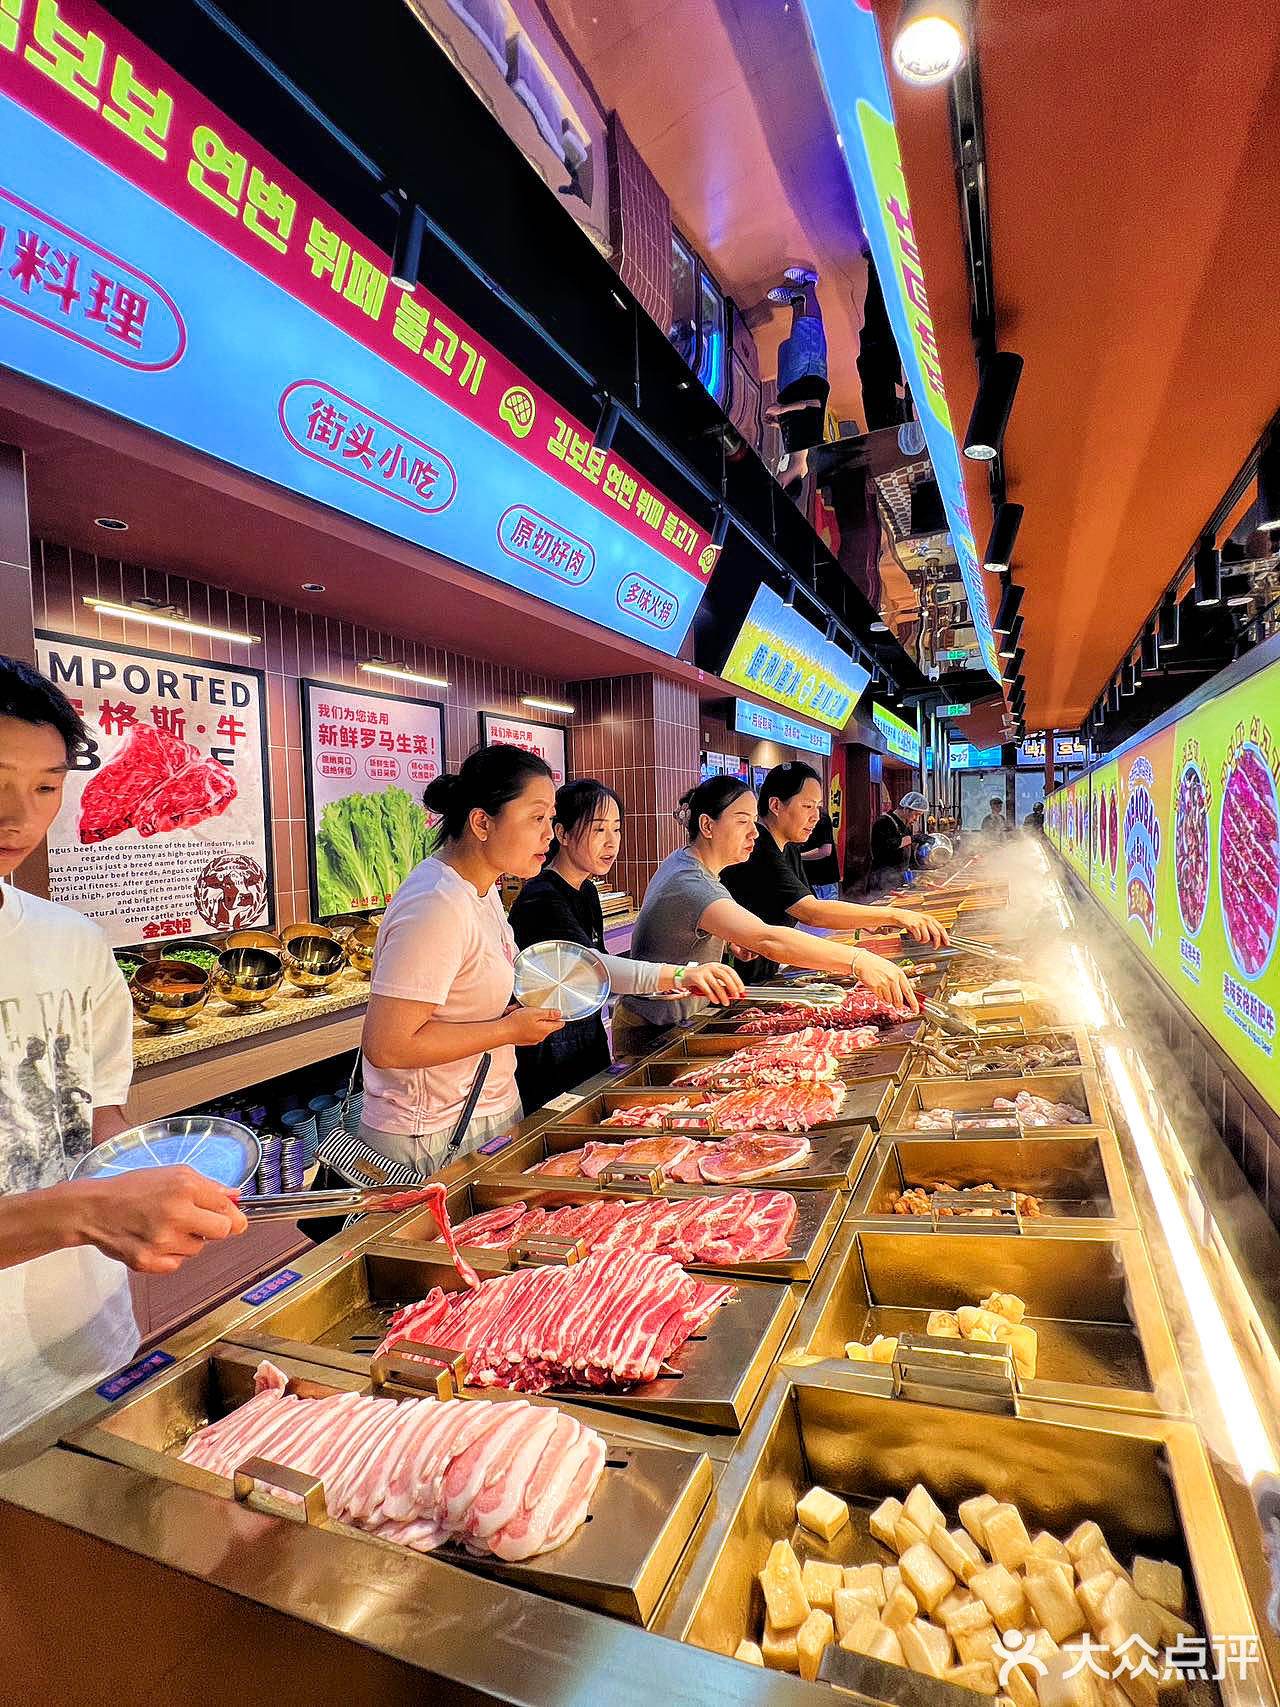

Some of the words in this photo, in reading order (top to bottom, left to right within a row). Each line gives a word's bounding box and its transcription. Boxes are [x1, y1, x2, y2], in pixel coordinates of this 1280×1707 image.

[187, 125, 297, 255] 연변
[304, 217, 389, 321] 뷔페
[392, 290, 487, 396] 불고기
[0, 225, 150, 350] 料理
[306, 398, 440, 500] 街头小吃
[547, 416, 607, 486] 김보보
[602, 463, 638, 511] 연변
[636, 488, 666, 530] 뷔페
[661, 511, 699, 556] 불고기
[511, 515, 587, 577] 原切好肉
[623, 582, 674, 623] 多味火锅
[46, 650, 251, 708] MPORTED
[318, 703, 390, 726] 我们为您选用
[491, 726, 533, 742] 我们承诺只用
[49, 847, 71, 855] ngus
[73, 845, 96, 853] beef,
[114, 843, 162, 851] cornerstone
[81, 854, 120, 862] regarded
[134, 852, 155, 860] many
[167, 849, 211, 858] high-quality
[66, 864, 94, 873] Angus
[104, 862, 121, 871] just
[74, 873, 108, 882] popular
[162, 868, 184, 876] Angus
[145, 878, 190, 886] generations
[51, 895, 69, 903] ield
[81, 892, 105, 900] high,
[106, 889, 148, 898] producing
[149, 885, 164, 893] rich
[166, 884, 192, 892] marble
[117, 898, 132, 906] and
[134, 894, 158, 904] bright
[120, 904, 168, 915] advantages
[125, 915, 148, 924] other
[150, 913, 174, 921] cattle
